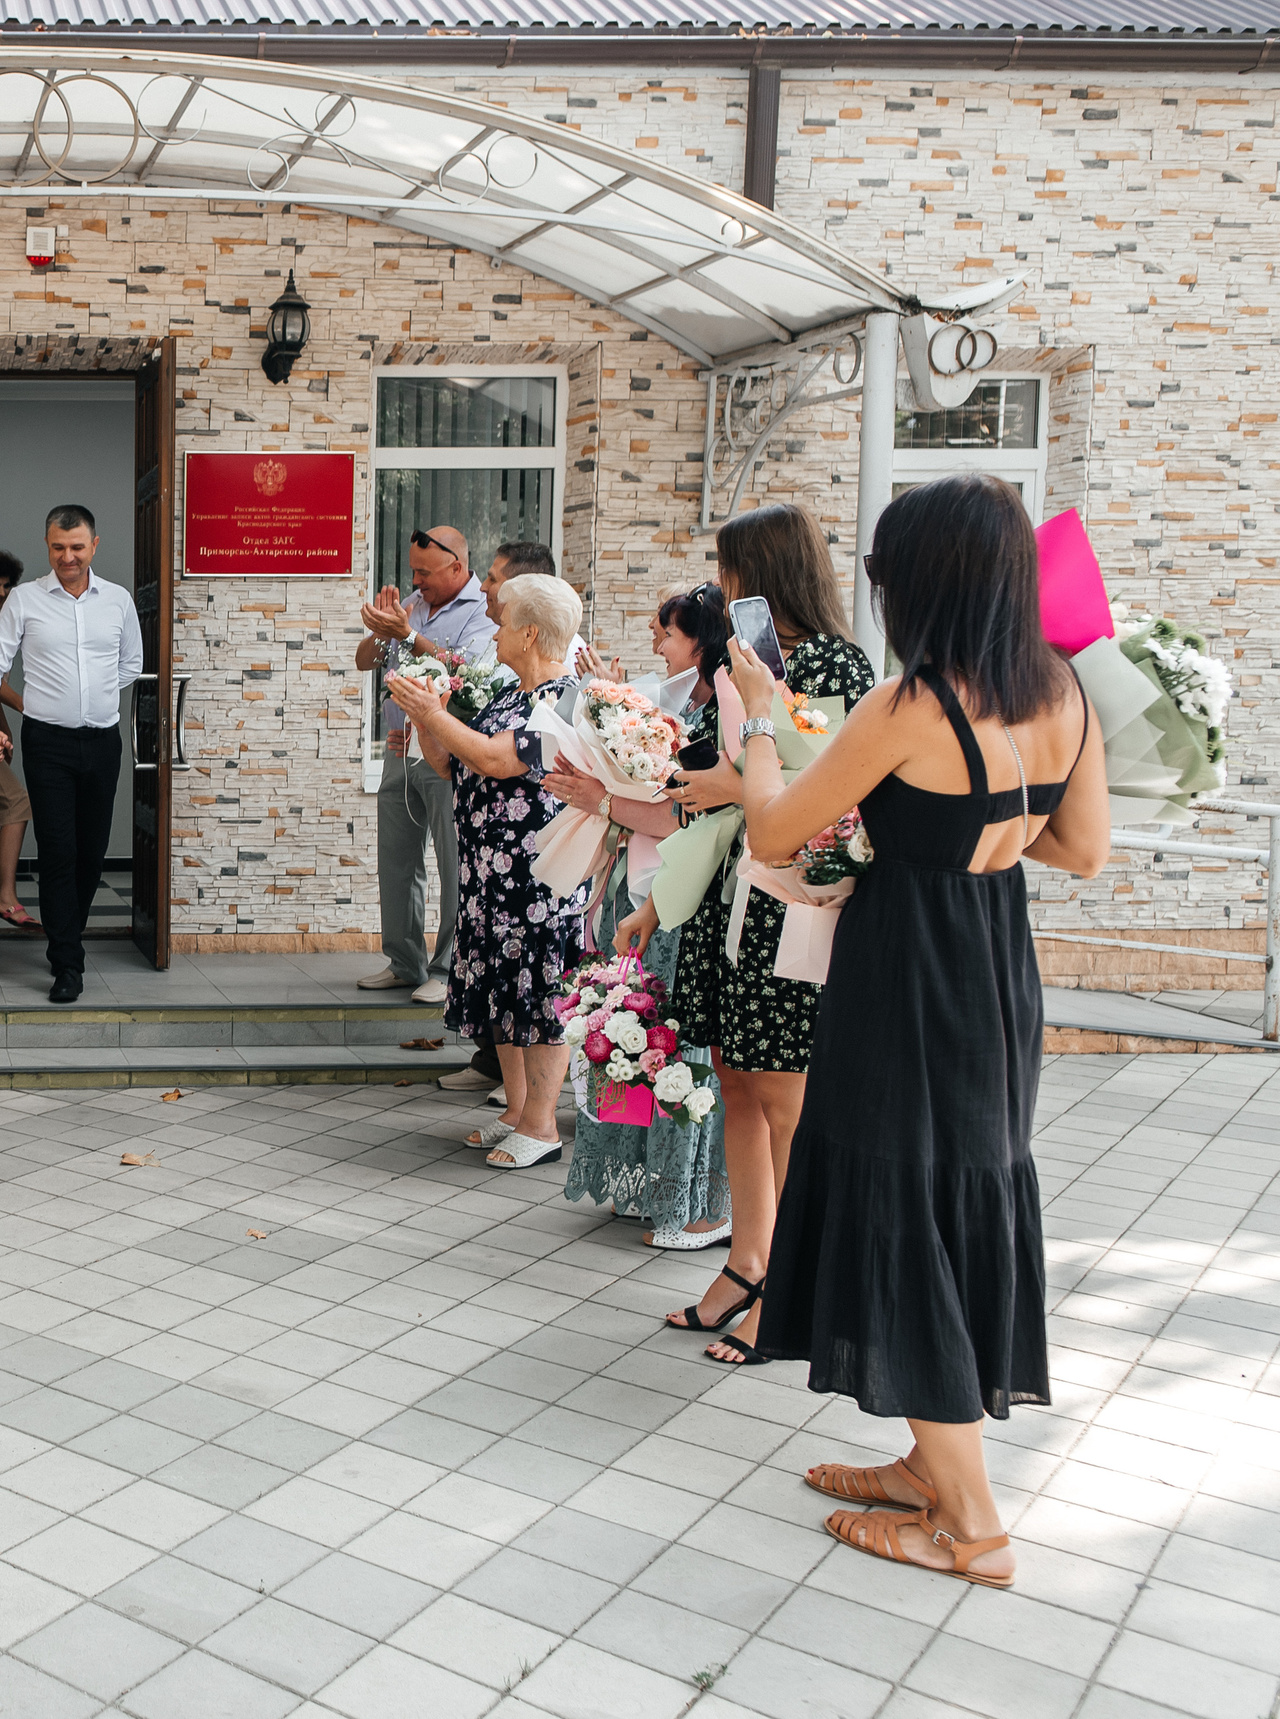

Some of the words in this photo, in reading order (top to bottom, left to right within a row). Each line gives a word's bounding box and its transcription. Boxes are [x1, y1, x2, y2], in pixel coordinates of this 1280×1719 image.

[243, 536, 269, 545] Отдел
[273, 536, 295, 544] ЗАГС
[200, 547, 303, 557] Приморско-Ахтарского
[307, 547, 338, 557] района
